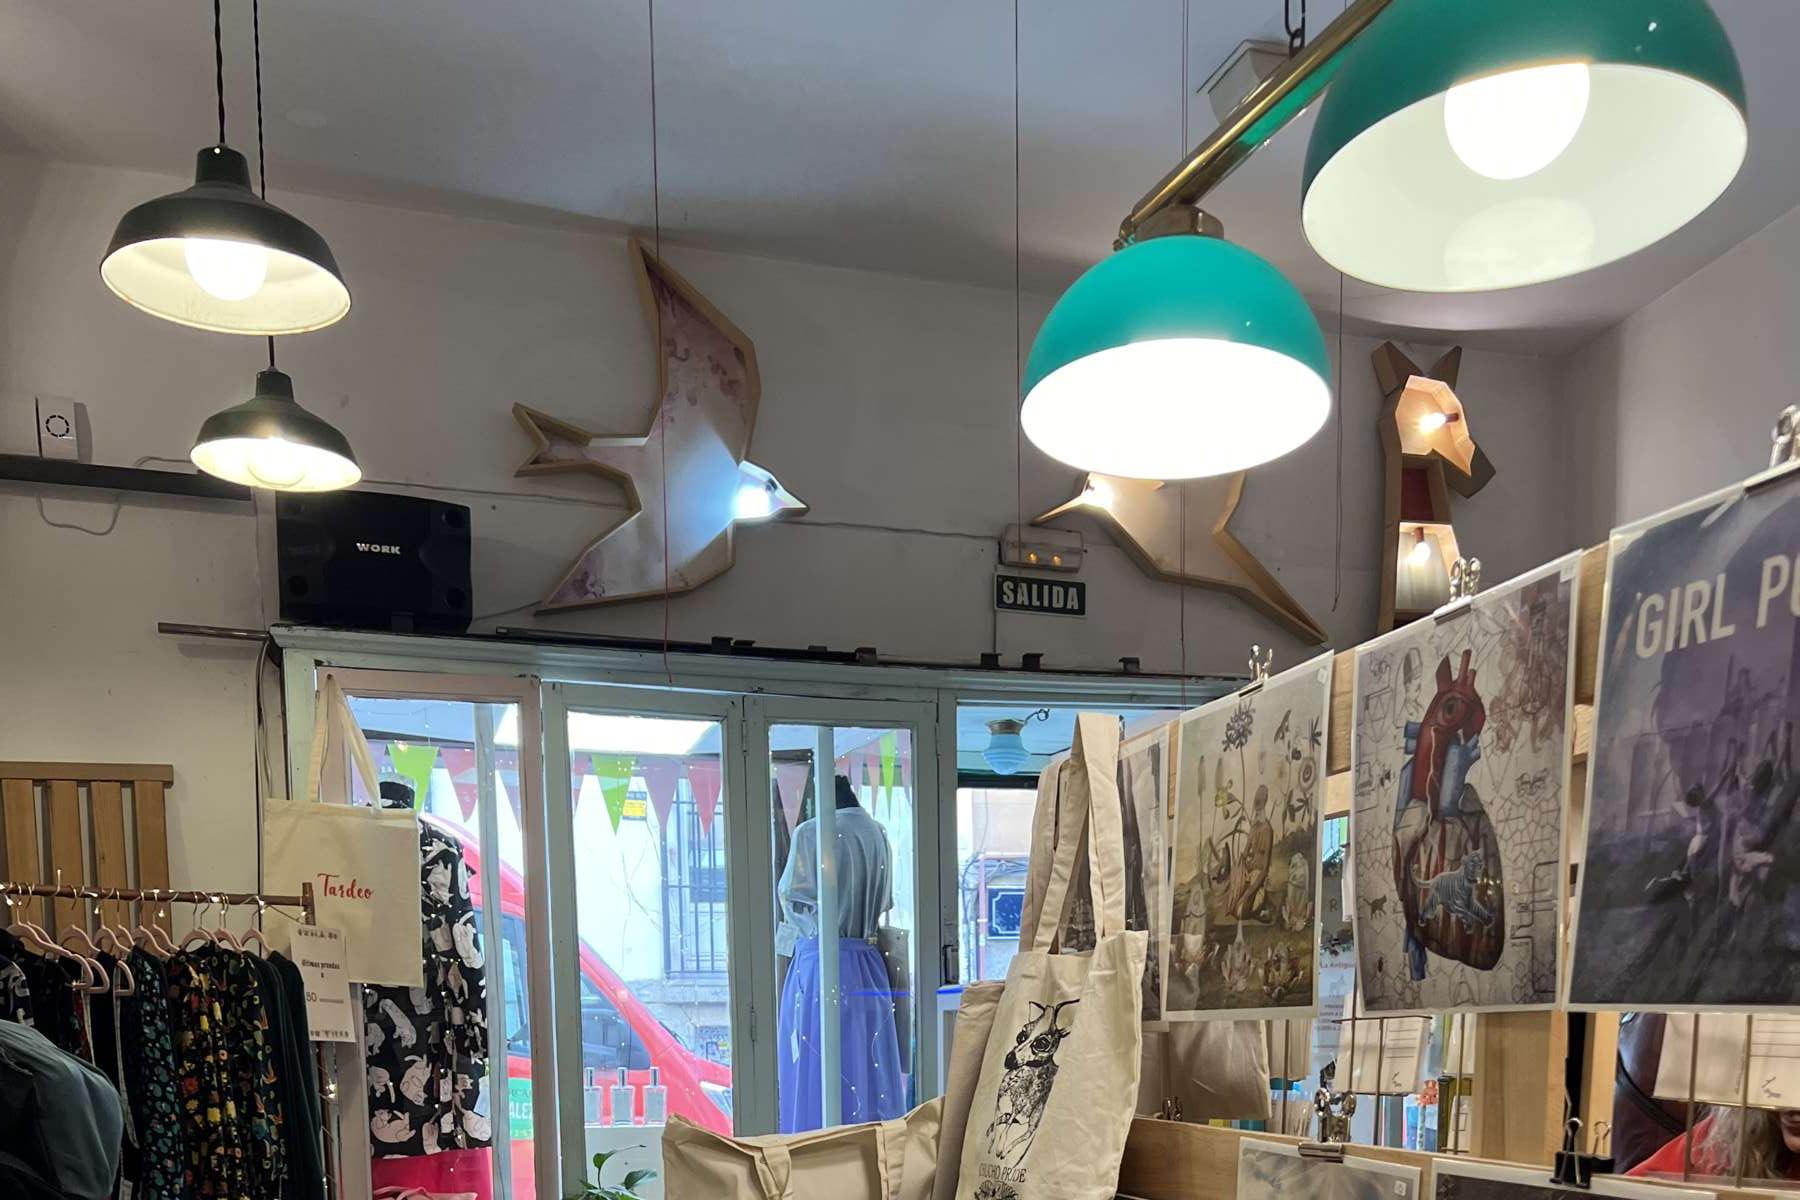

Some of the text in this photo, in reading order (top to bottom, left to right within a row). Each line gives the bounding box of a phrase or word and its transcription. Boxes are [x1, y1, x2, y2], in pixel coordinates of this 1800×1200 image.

[356, 543, 400, 555] WORK
[1002, 580, 1079, 609] SALIDA
[1636, 573, 1736, 658] GIRL
[317, 872, 373, 899] Tardeo
